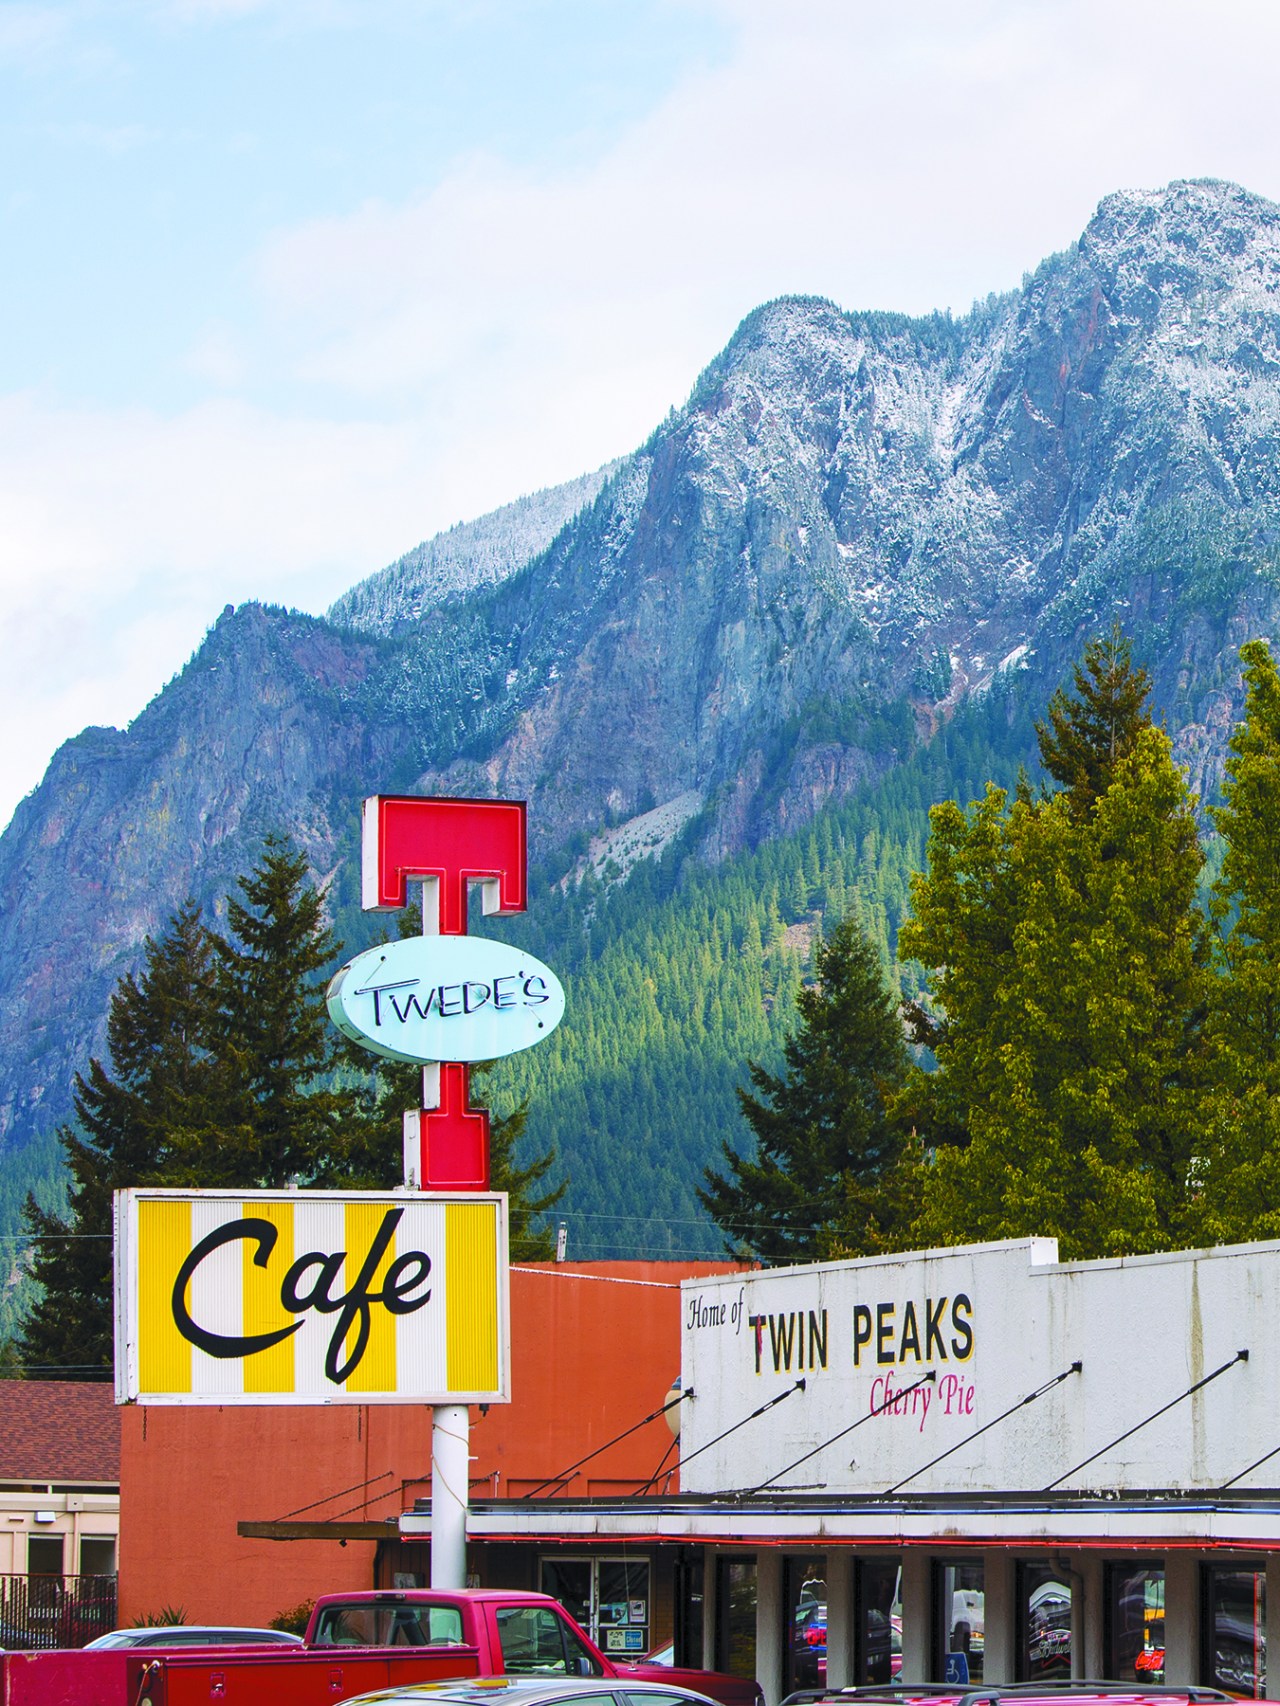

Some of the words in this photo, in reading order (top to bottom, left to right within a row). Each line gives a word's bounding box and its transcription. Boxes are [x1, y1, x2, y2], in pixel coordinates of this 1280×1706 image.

[354, 971, 550, 1026] TWEDE'S
[172, 1208, 432, 1384] Cafe
[687, 1296, 726, 1330] Home
[731, 1287, 745, 1335] of
[748, 1308, 828, 1376] TWIN
[853, 1293, 975, 1369] PEAKS
[870, 1370, 932, 1432] Cherry
[938, 1373, 975, 1415] Pie
[806, 1628, 827, 1645] OPE
